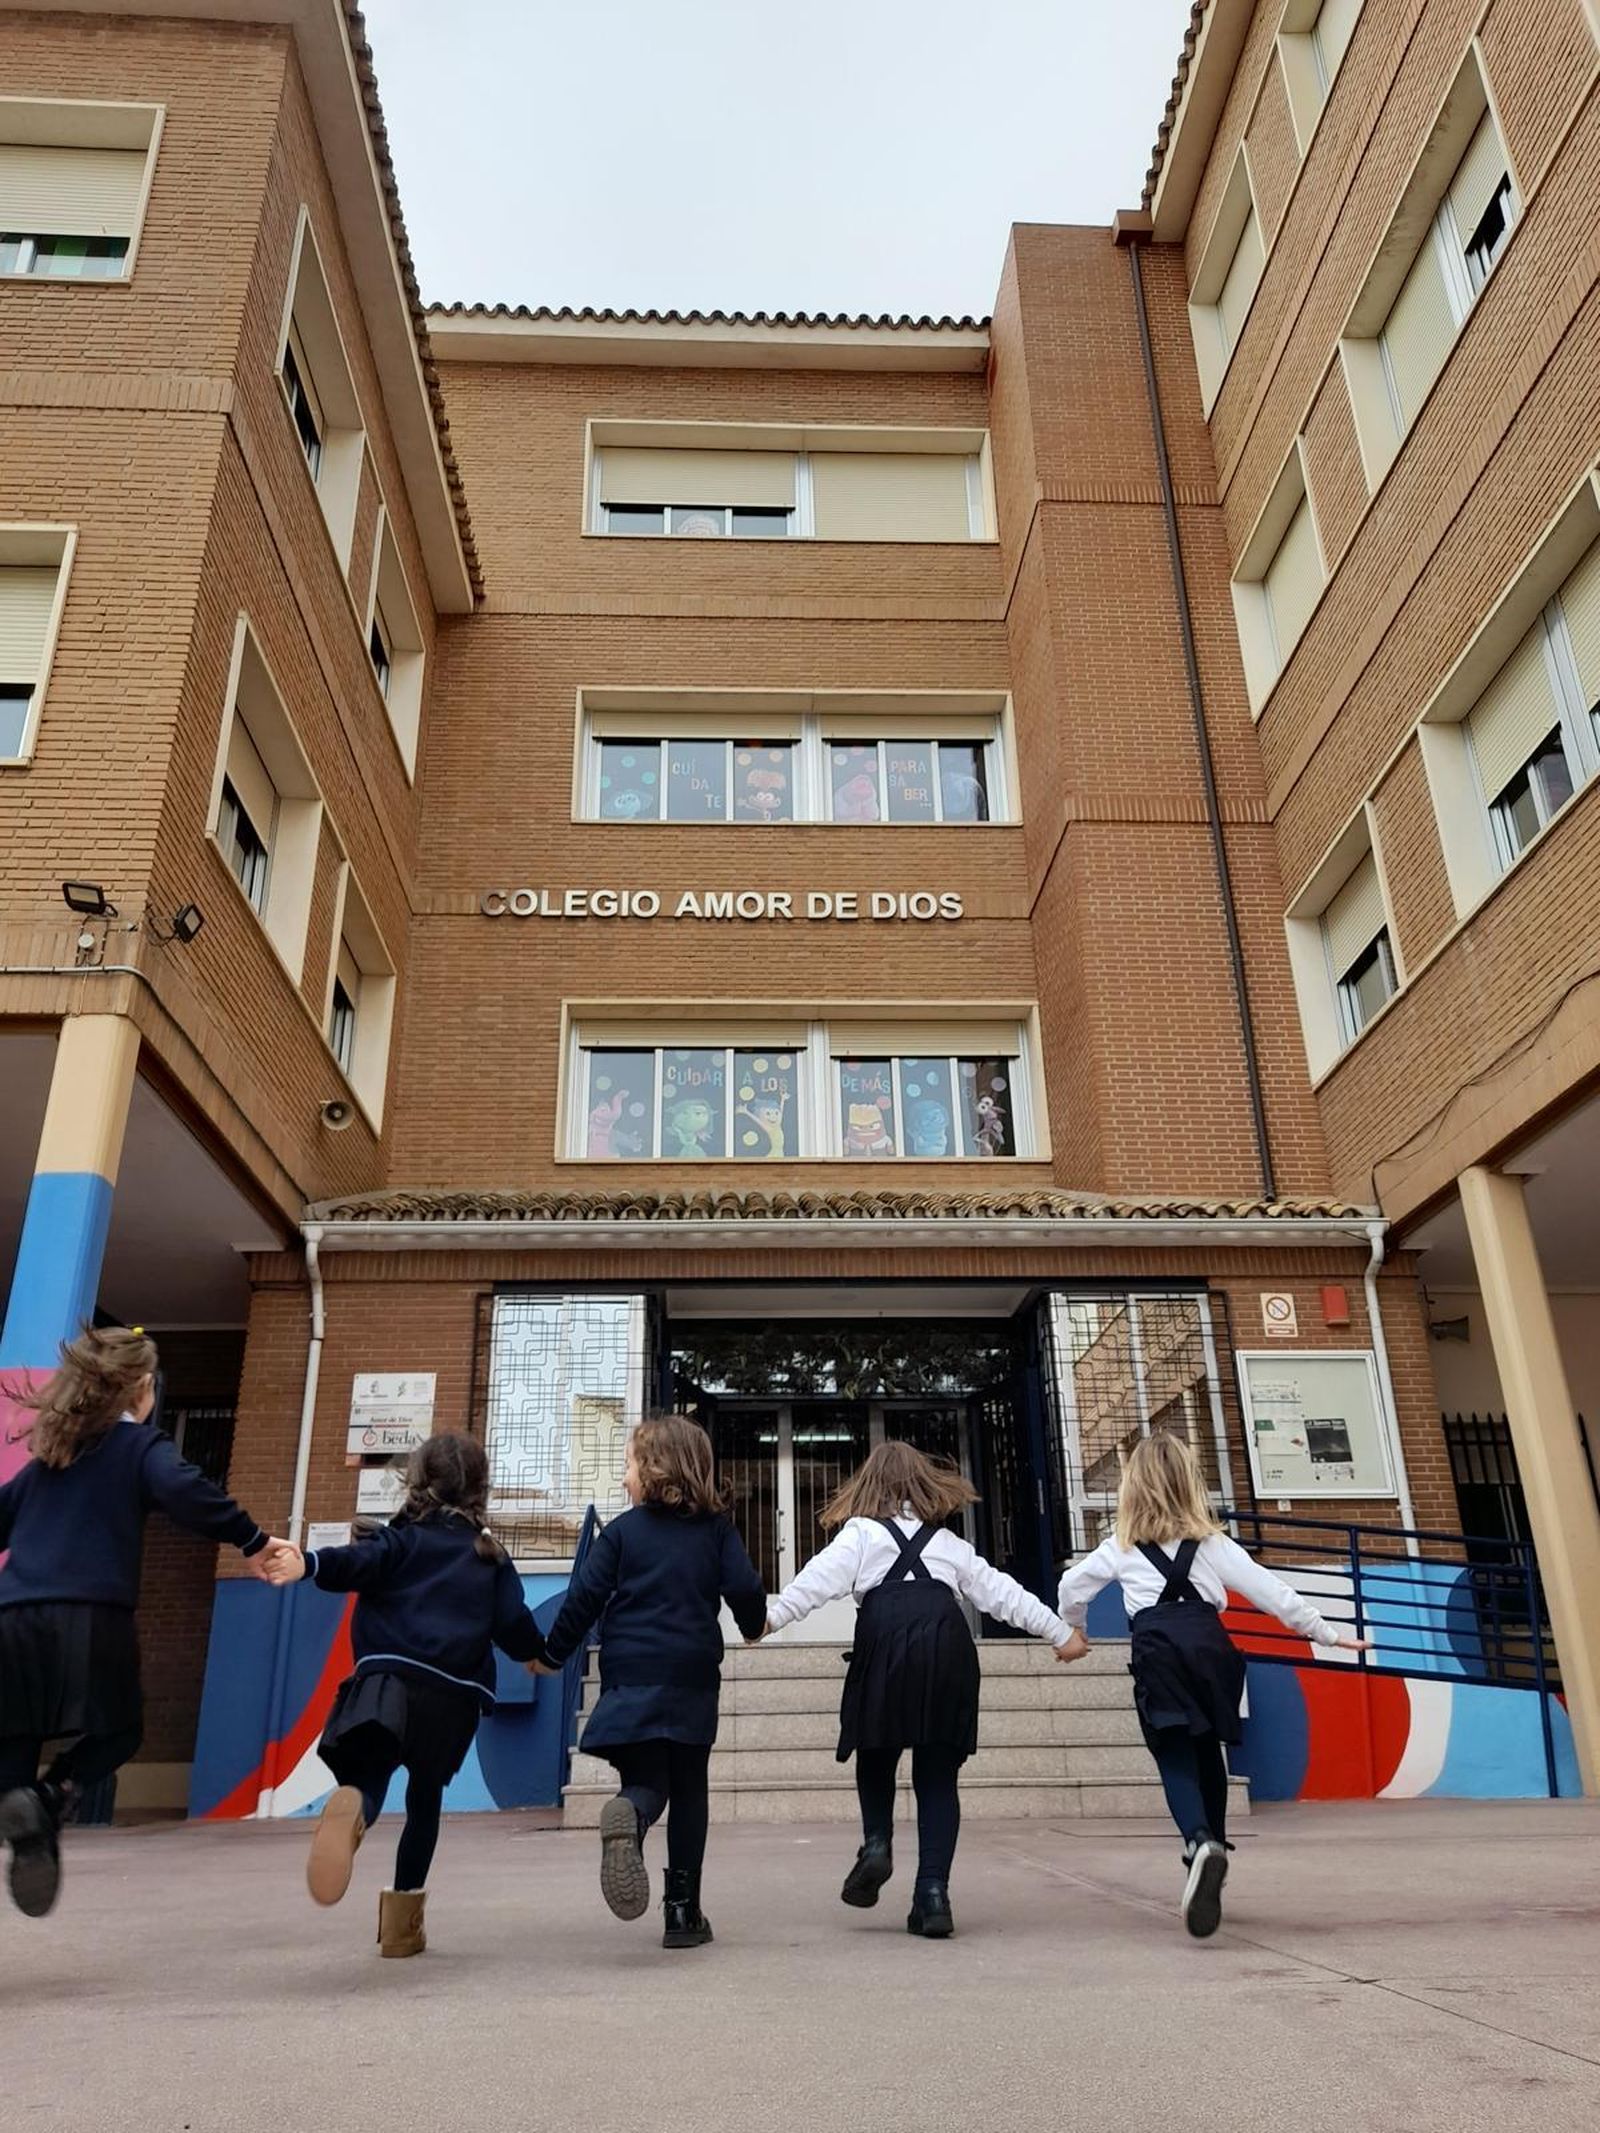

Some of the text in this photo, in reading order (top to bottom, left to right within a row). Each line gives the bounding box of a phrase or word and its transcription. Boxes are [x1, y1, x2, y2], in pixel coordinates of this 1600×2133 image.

[691, 778, 709, 790] DA
[704, 793, 721, 808] TE
[481, 889, 964, 920] COLEGIO AMOR DE DIOS
[667, 1066, 723, 1087] CUIDAR
[742, 1071, 753, 1086] A
[761, 1077, 788, 1093] LOS
